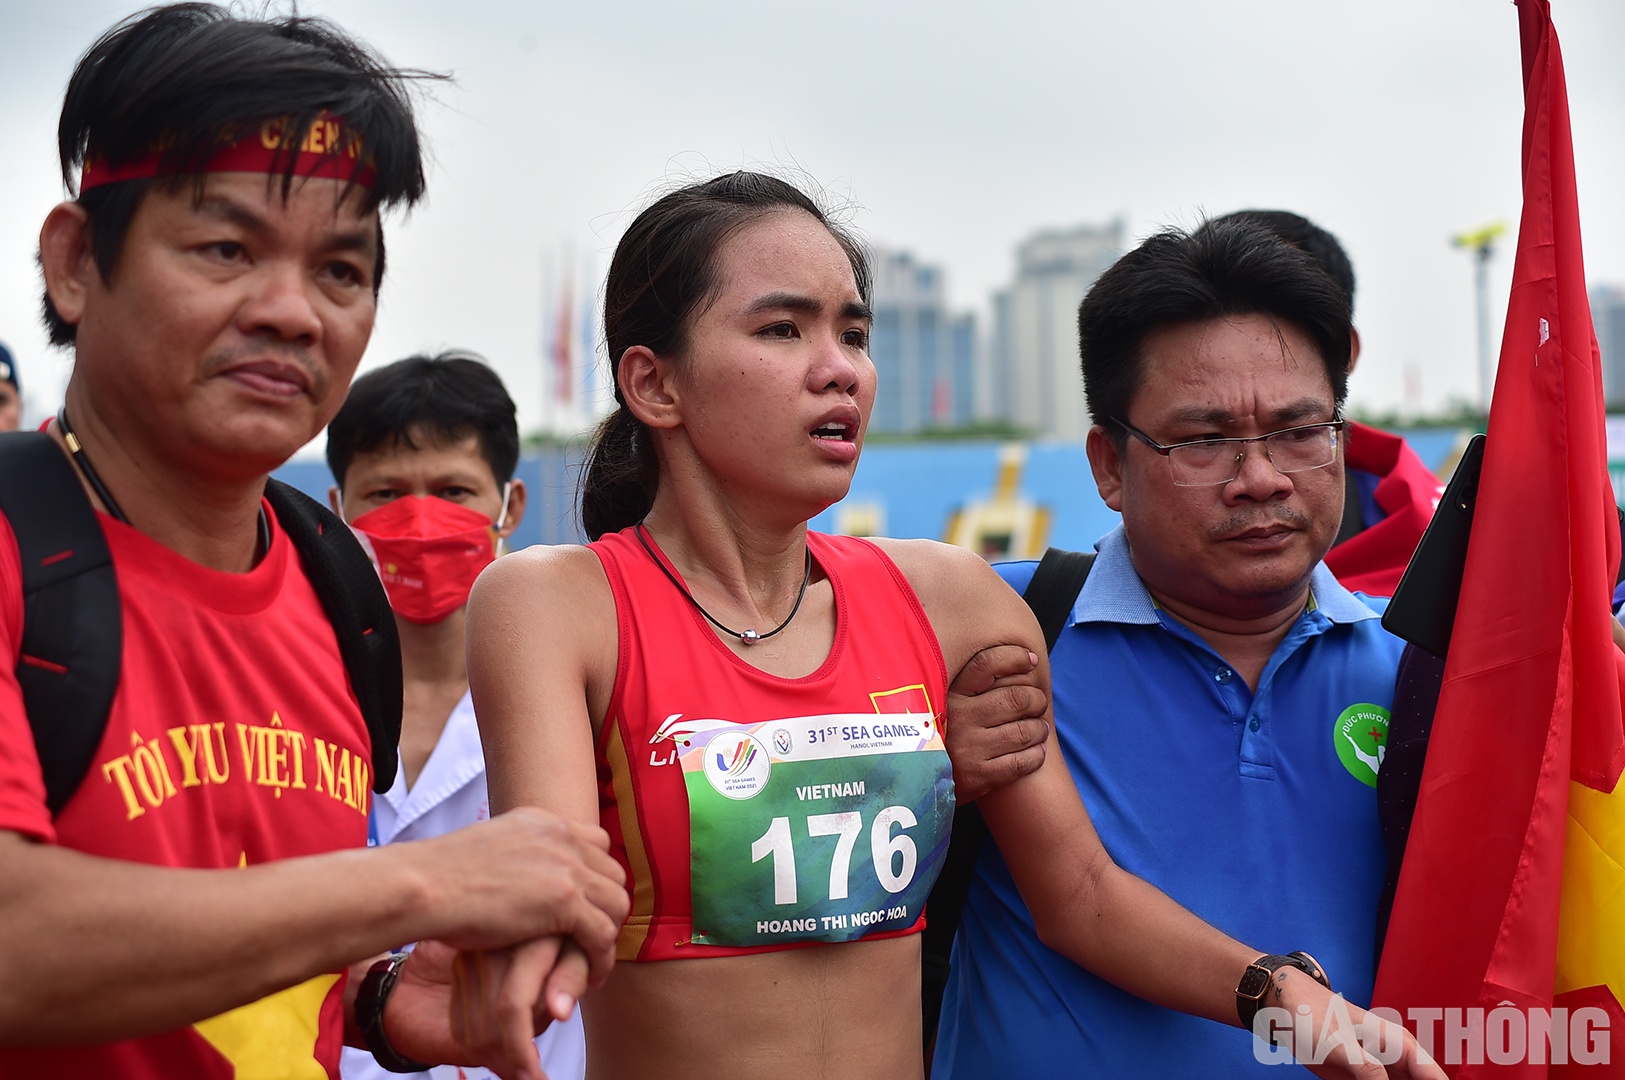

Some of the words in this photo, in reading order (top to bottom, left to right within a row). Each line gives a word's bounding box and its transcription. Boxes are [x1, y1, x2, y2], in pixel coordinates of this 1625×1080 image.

[808, 727, 838, 744] 31ST
[842, 725, 871, 741] SEA
[872, 724, 920, 739] GAMES
[870, 741, 893, 749] VIETNAM
[102, 730, 177, 821] TÔI
[167, 721, 230, 788] YU
[235, 711, 308, 799] VIỆT
[313, 737, 369, 816] NAM
[796, 780, 866, 801] VIETNAM
[751, 805, 918, 905] 176
[756, 917, 817, 934] HOANG
[821, 914, 848, 930] THI
[850, 909, 885, 927] NGOC
[886, 905, 907, 921] HOA
